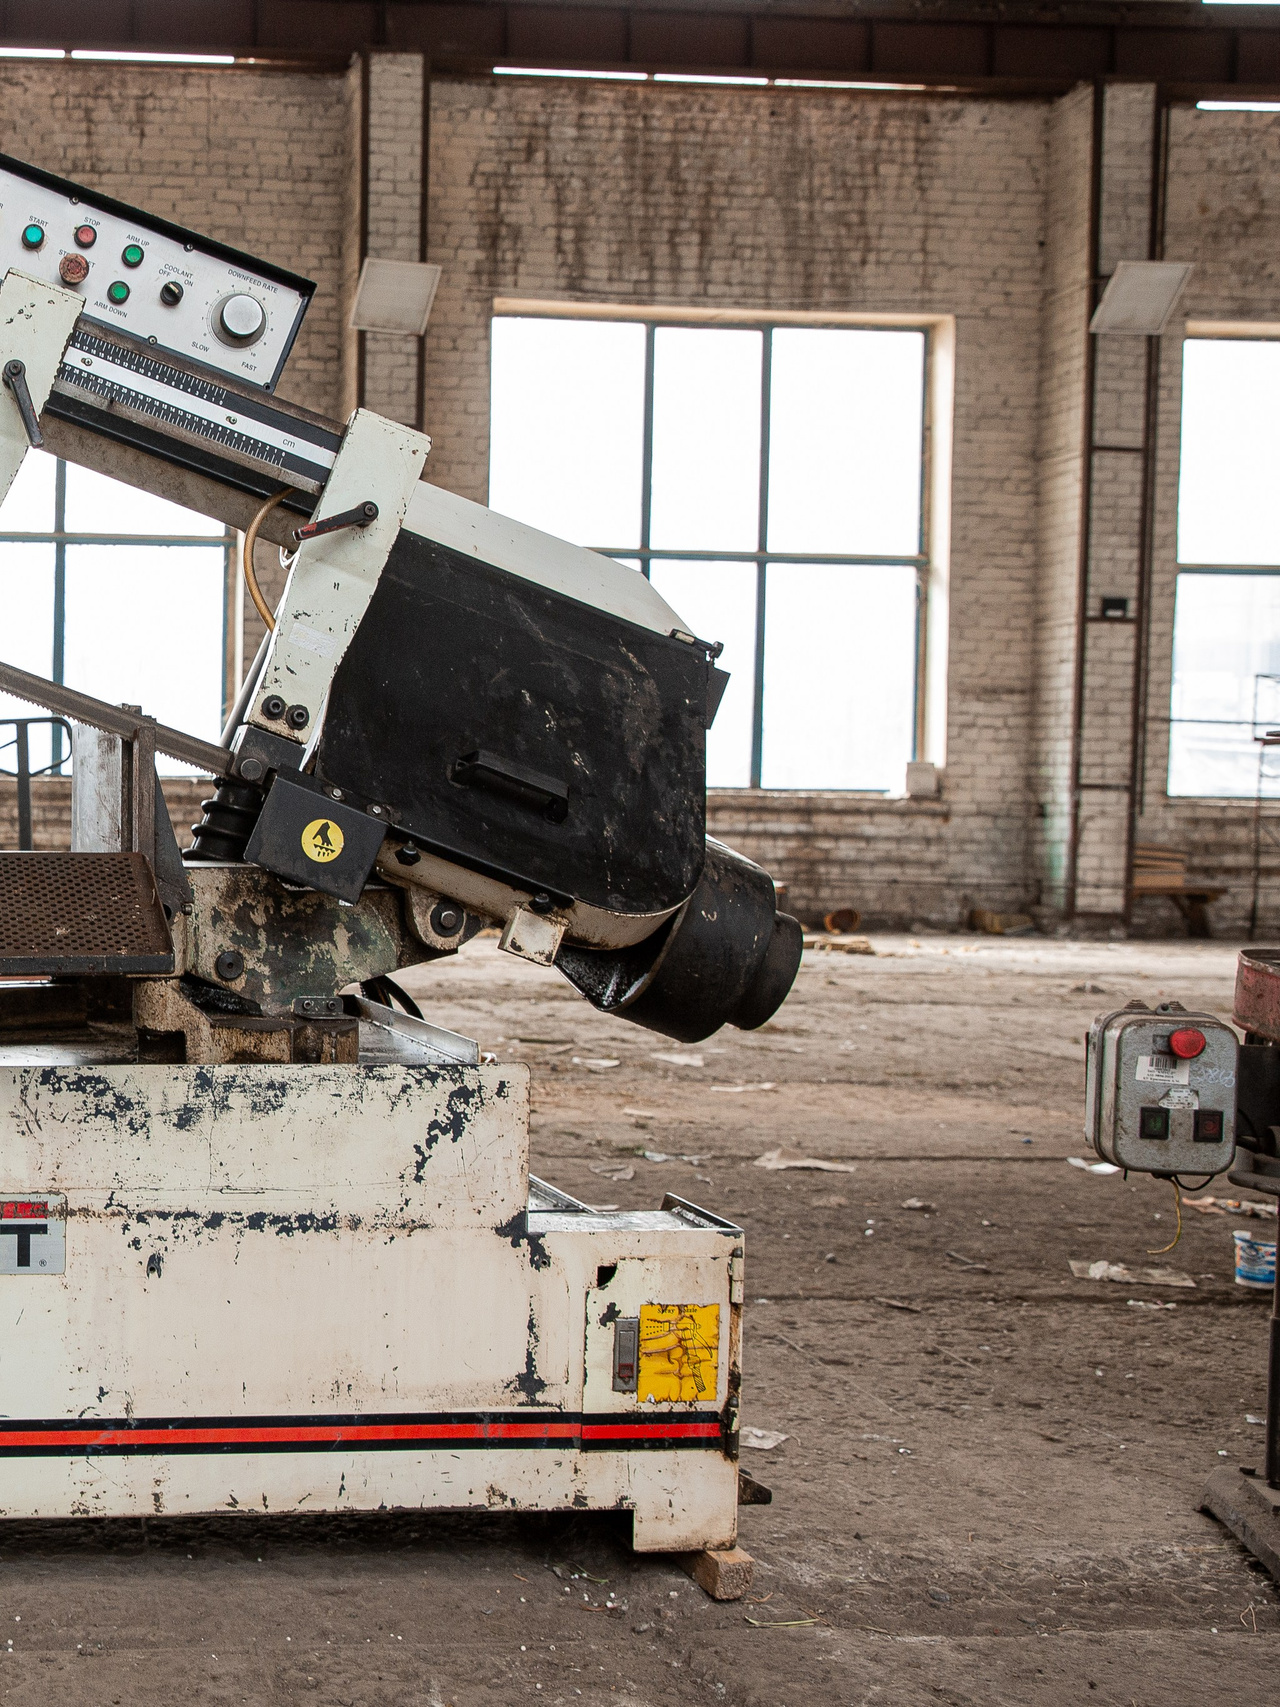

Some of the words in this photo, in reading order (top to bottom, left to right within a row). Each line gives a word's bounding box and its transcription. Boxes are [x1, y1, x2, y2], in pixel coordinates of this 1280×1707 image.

[29, 215, 48, 228] START
[84, 217, 100, 227] STOP
[126, 234, 140, 243] ARM
[159, 269, 171, 277] OFF
[164, 264, 193, 279] COOLANT
[228, 269, 262, 287] DOWNFEED
[262, 282, 278, 294] RATE
[94, 300, 108, 310] ARM
[108, 306, 128, 318] DOWN
[191, 341, 210, 352] SLOW
[241, 362, 257, 372] FAST
[282, 438, 296, 449] cm
